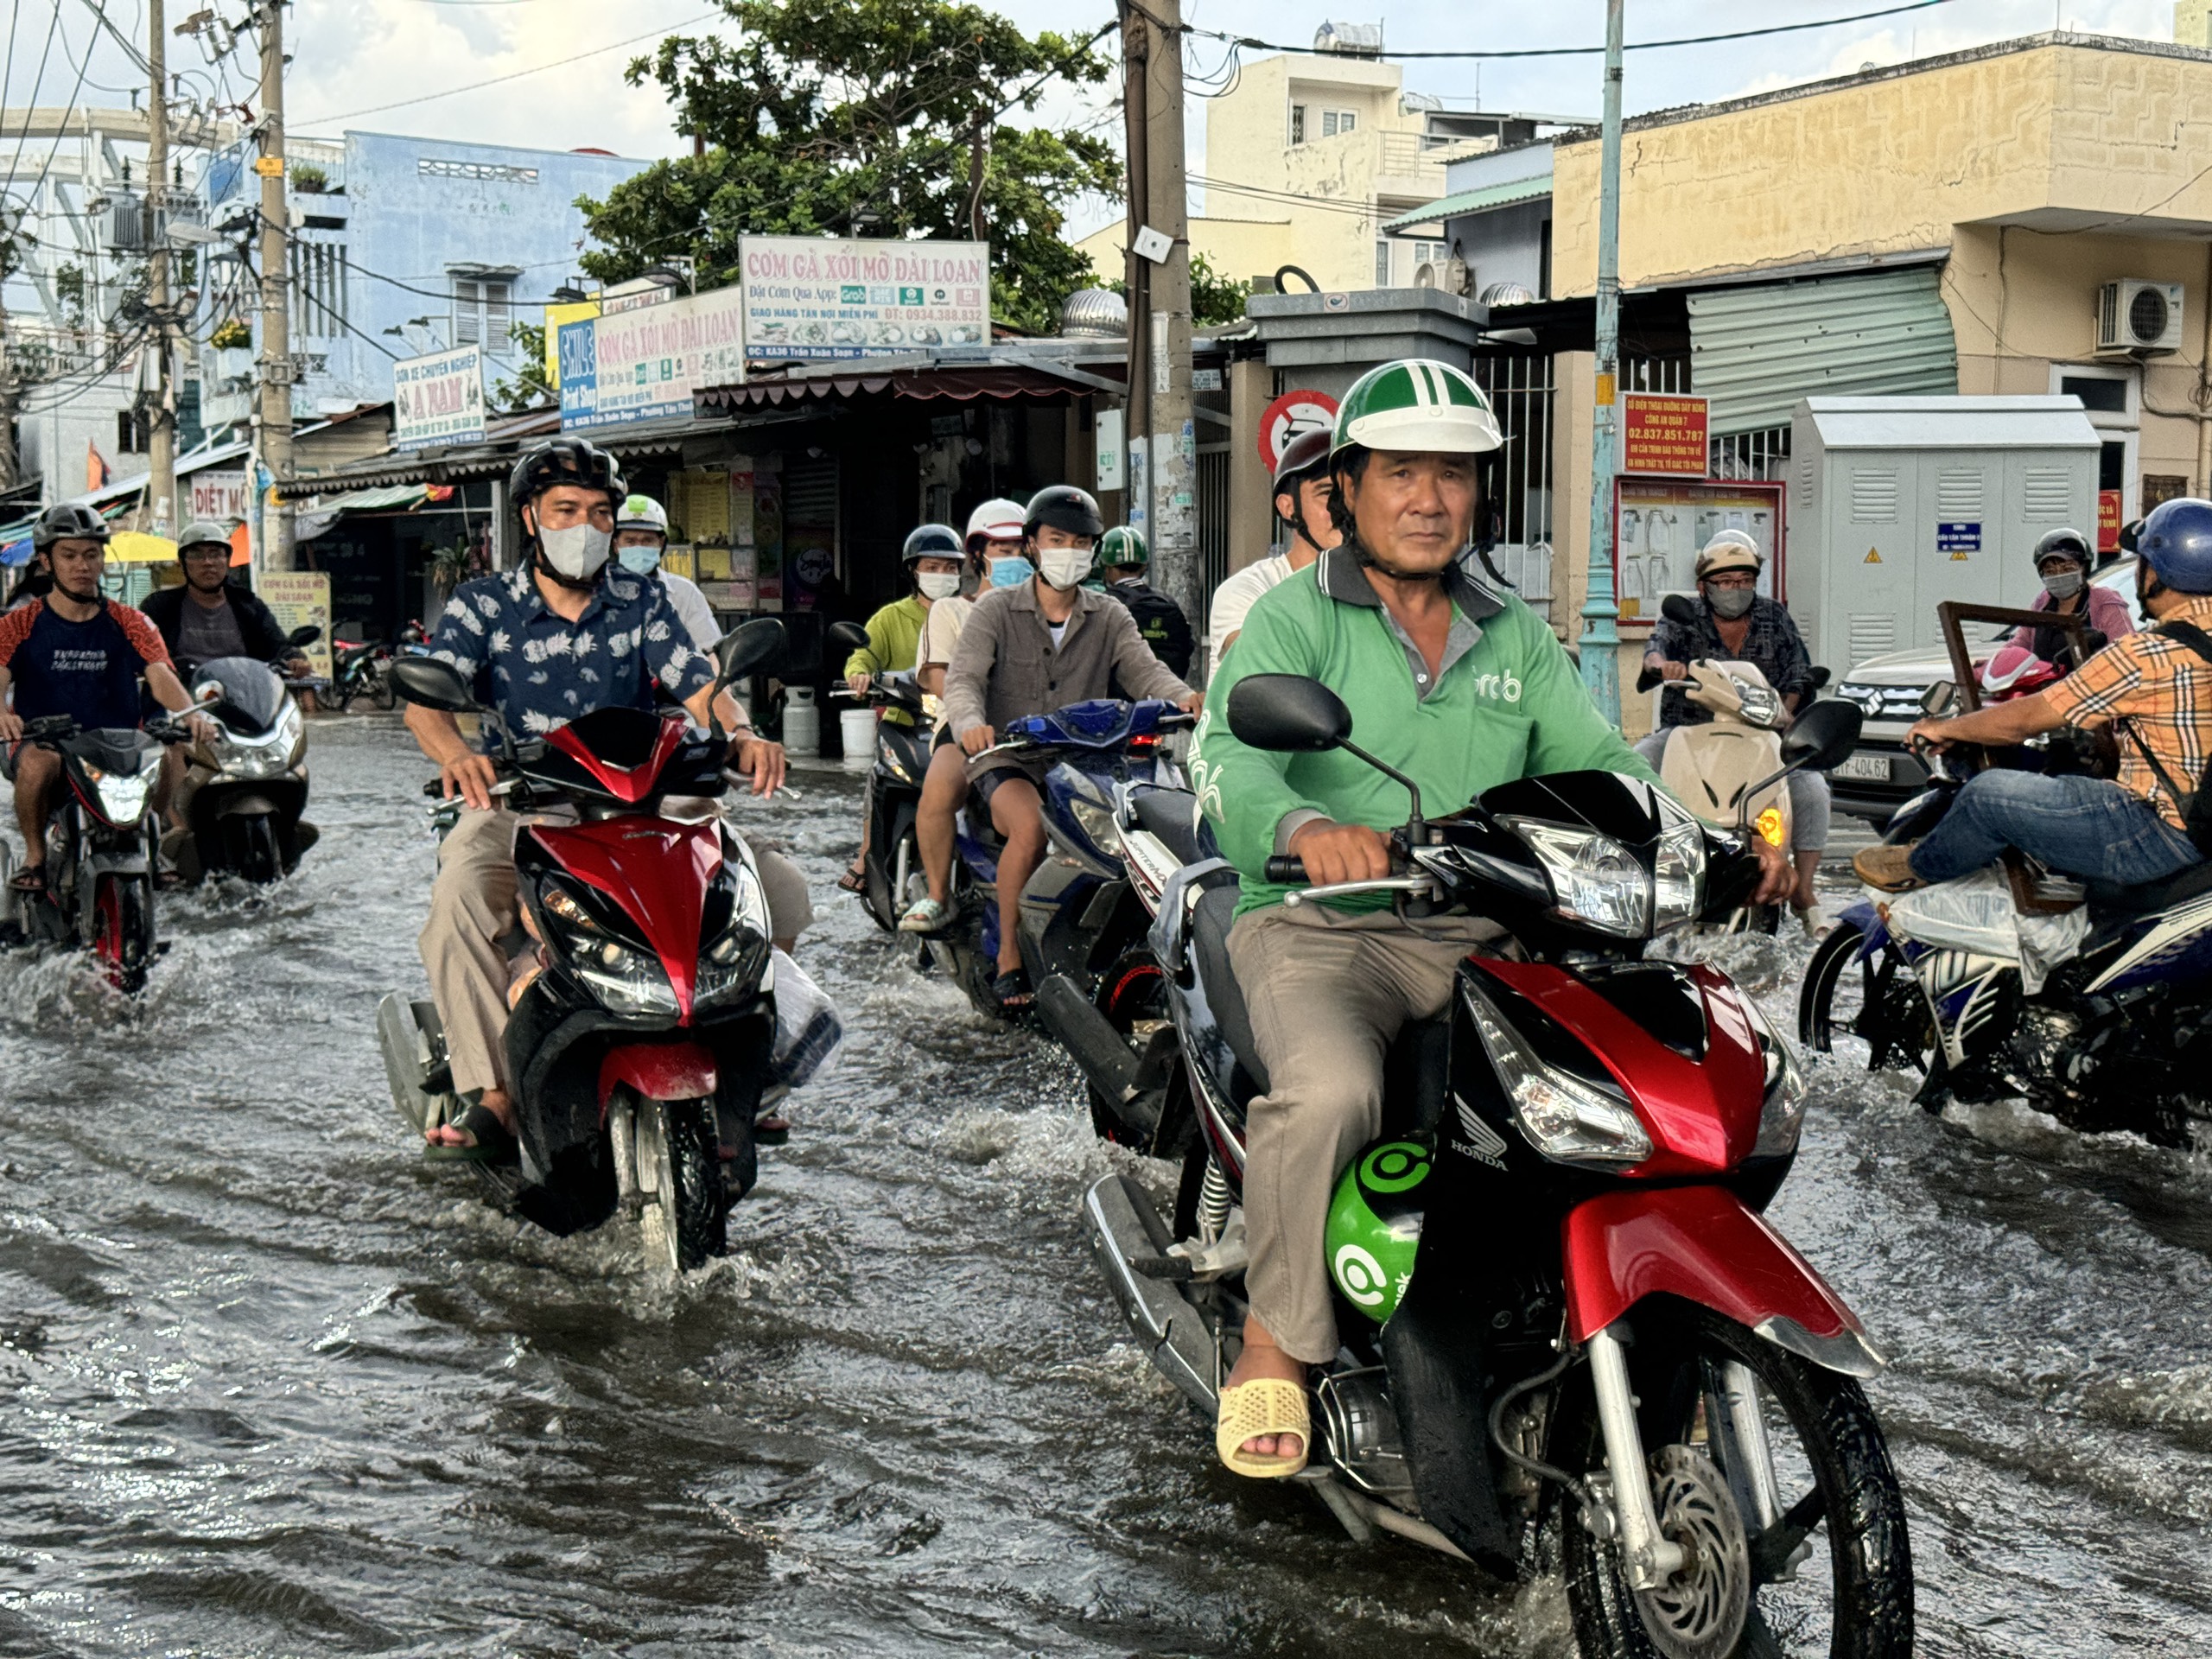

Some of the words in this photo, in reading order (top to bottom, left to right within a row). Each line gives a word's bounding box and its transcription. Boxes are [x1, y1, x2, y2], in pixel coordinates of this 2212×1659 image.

[747, 249, 787, 278] CƠM
[793, 247, 820, 279] GÀ
[824, 245, 858, 280] XỐI
[863, 251, 890, 282] MỠ
[894, 251, 927, 283] ĐÀI
[933, 258, 982, 284] LOAN
[793, 287, 811, 302] Qua
[841, 288, 865, 302] Grab
[750, 308, 772, 318] GIAO
[773, 307, 798, 319] HÀNG
[906, 309, 982, 321] 0934.388.832
[1628, 427, 1704, 442] 02.837.851.787
[1473, 665, 1522, 702] rab
[1451, 1139, 1509, 1172] HONDA
